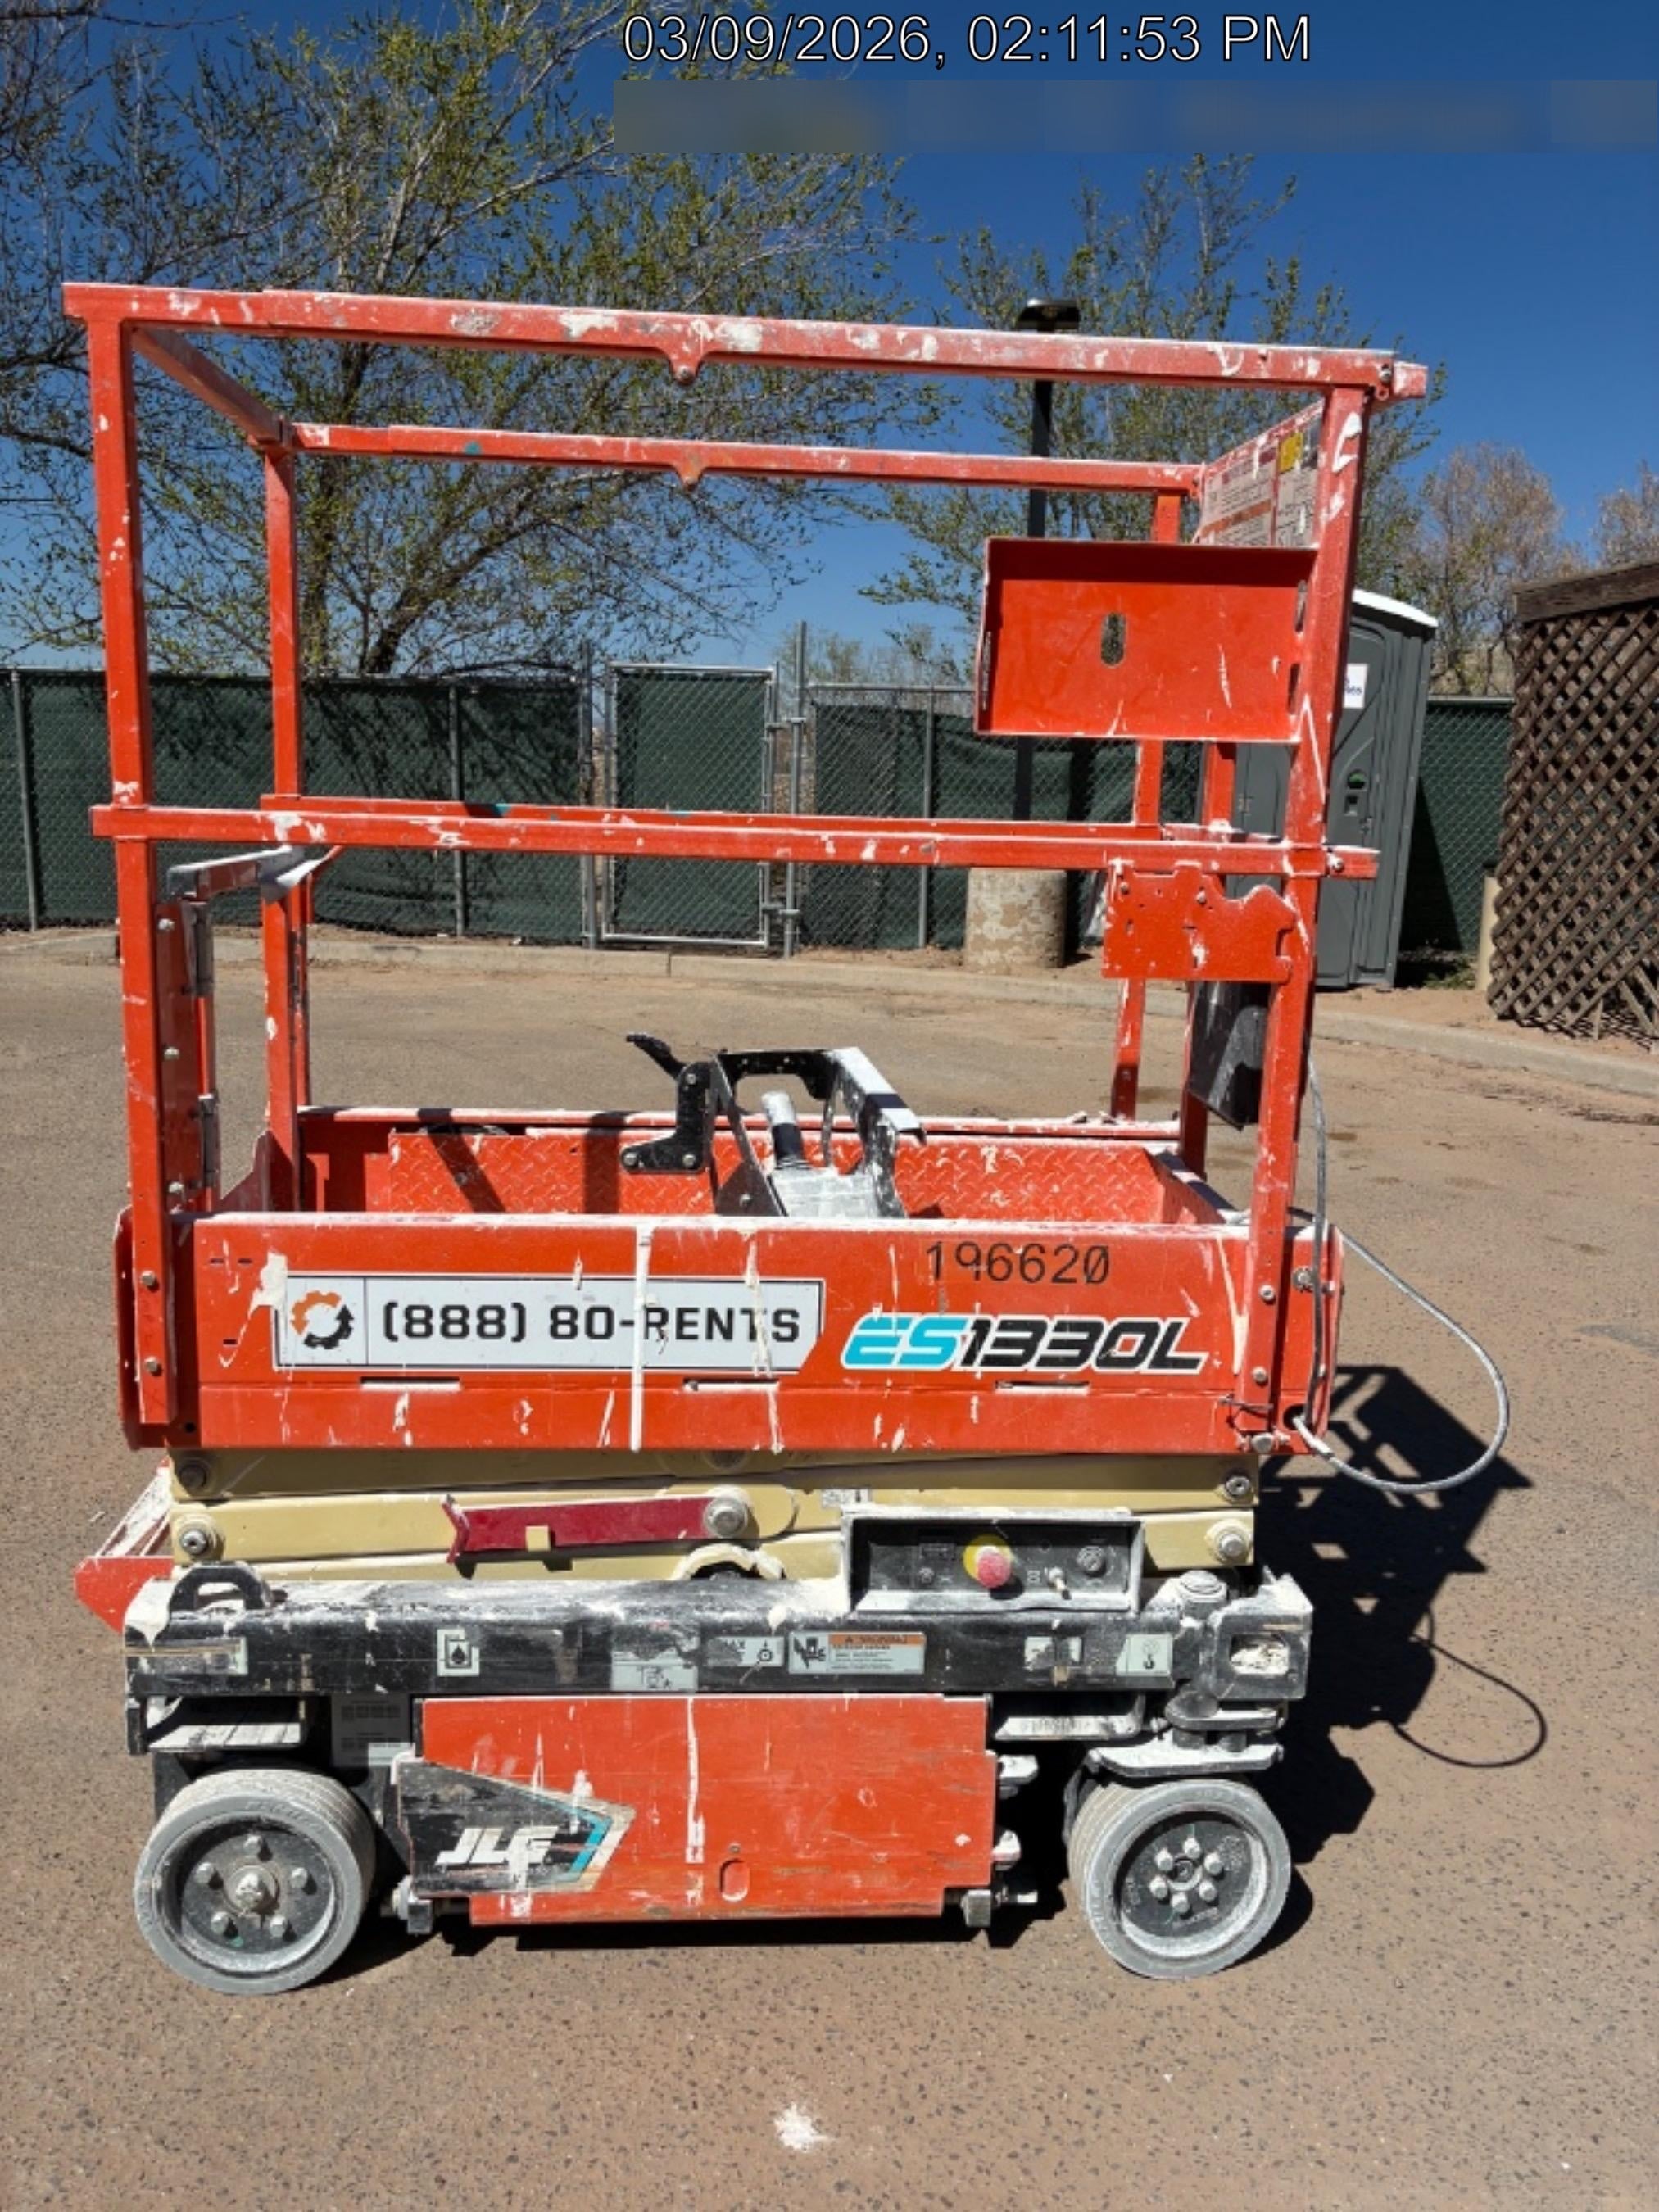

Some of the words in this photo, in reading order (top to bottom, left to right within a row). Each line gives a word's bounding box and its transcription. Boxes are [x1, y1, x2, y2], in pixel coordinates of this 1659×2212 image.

[925, 1240, 1111, 1286] 196620
[383, 1301, 526, 1343] (888)
[549, 1304, 801, 1343] 80-RENTS
[843, 1316, 1207, 1371] ES1330L
